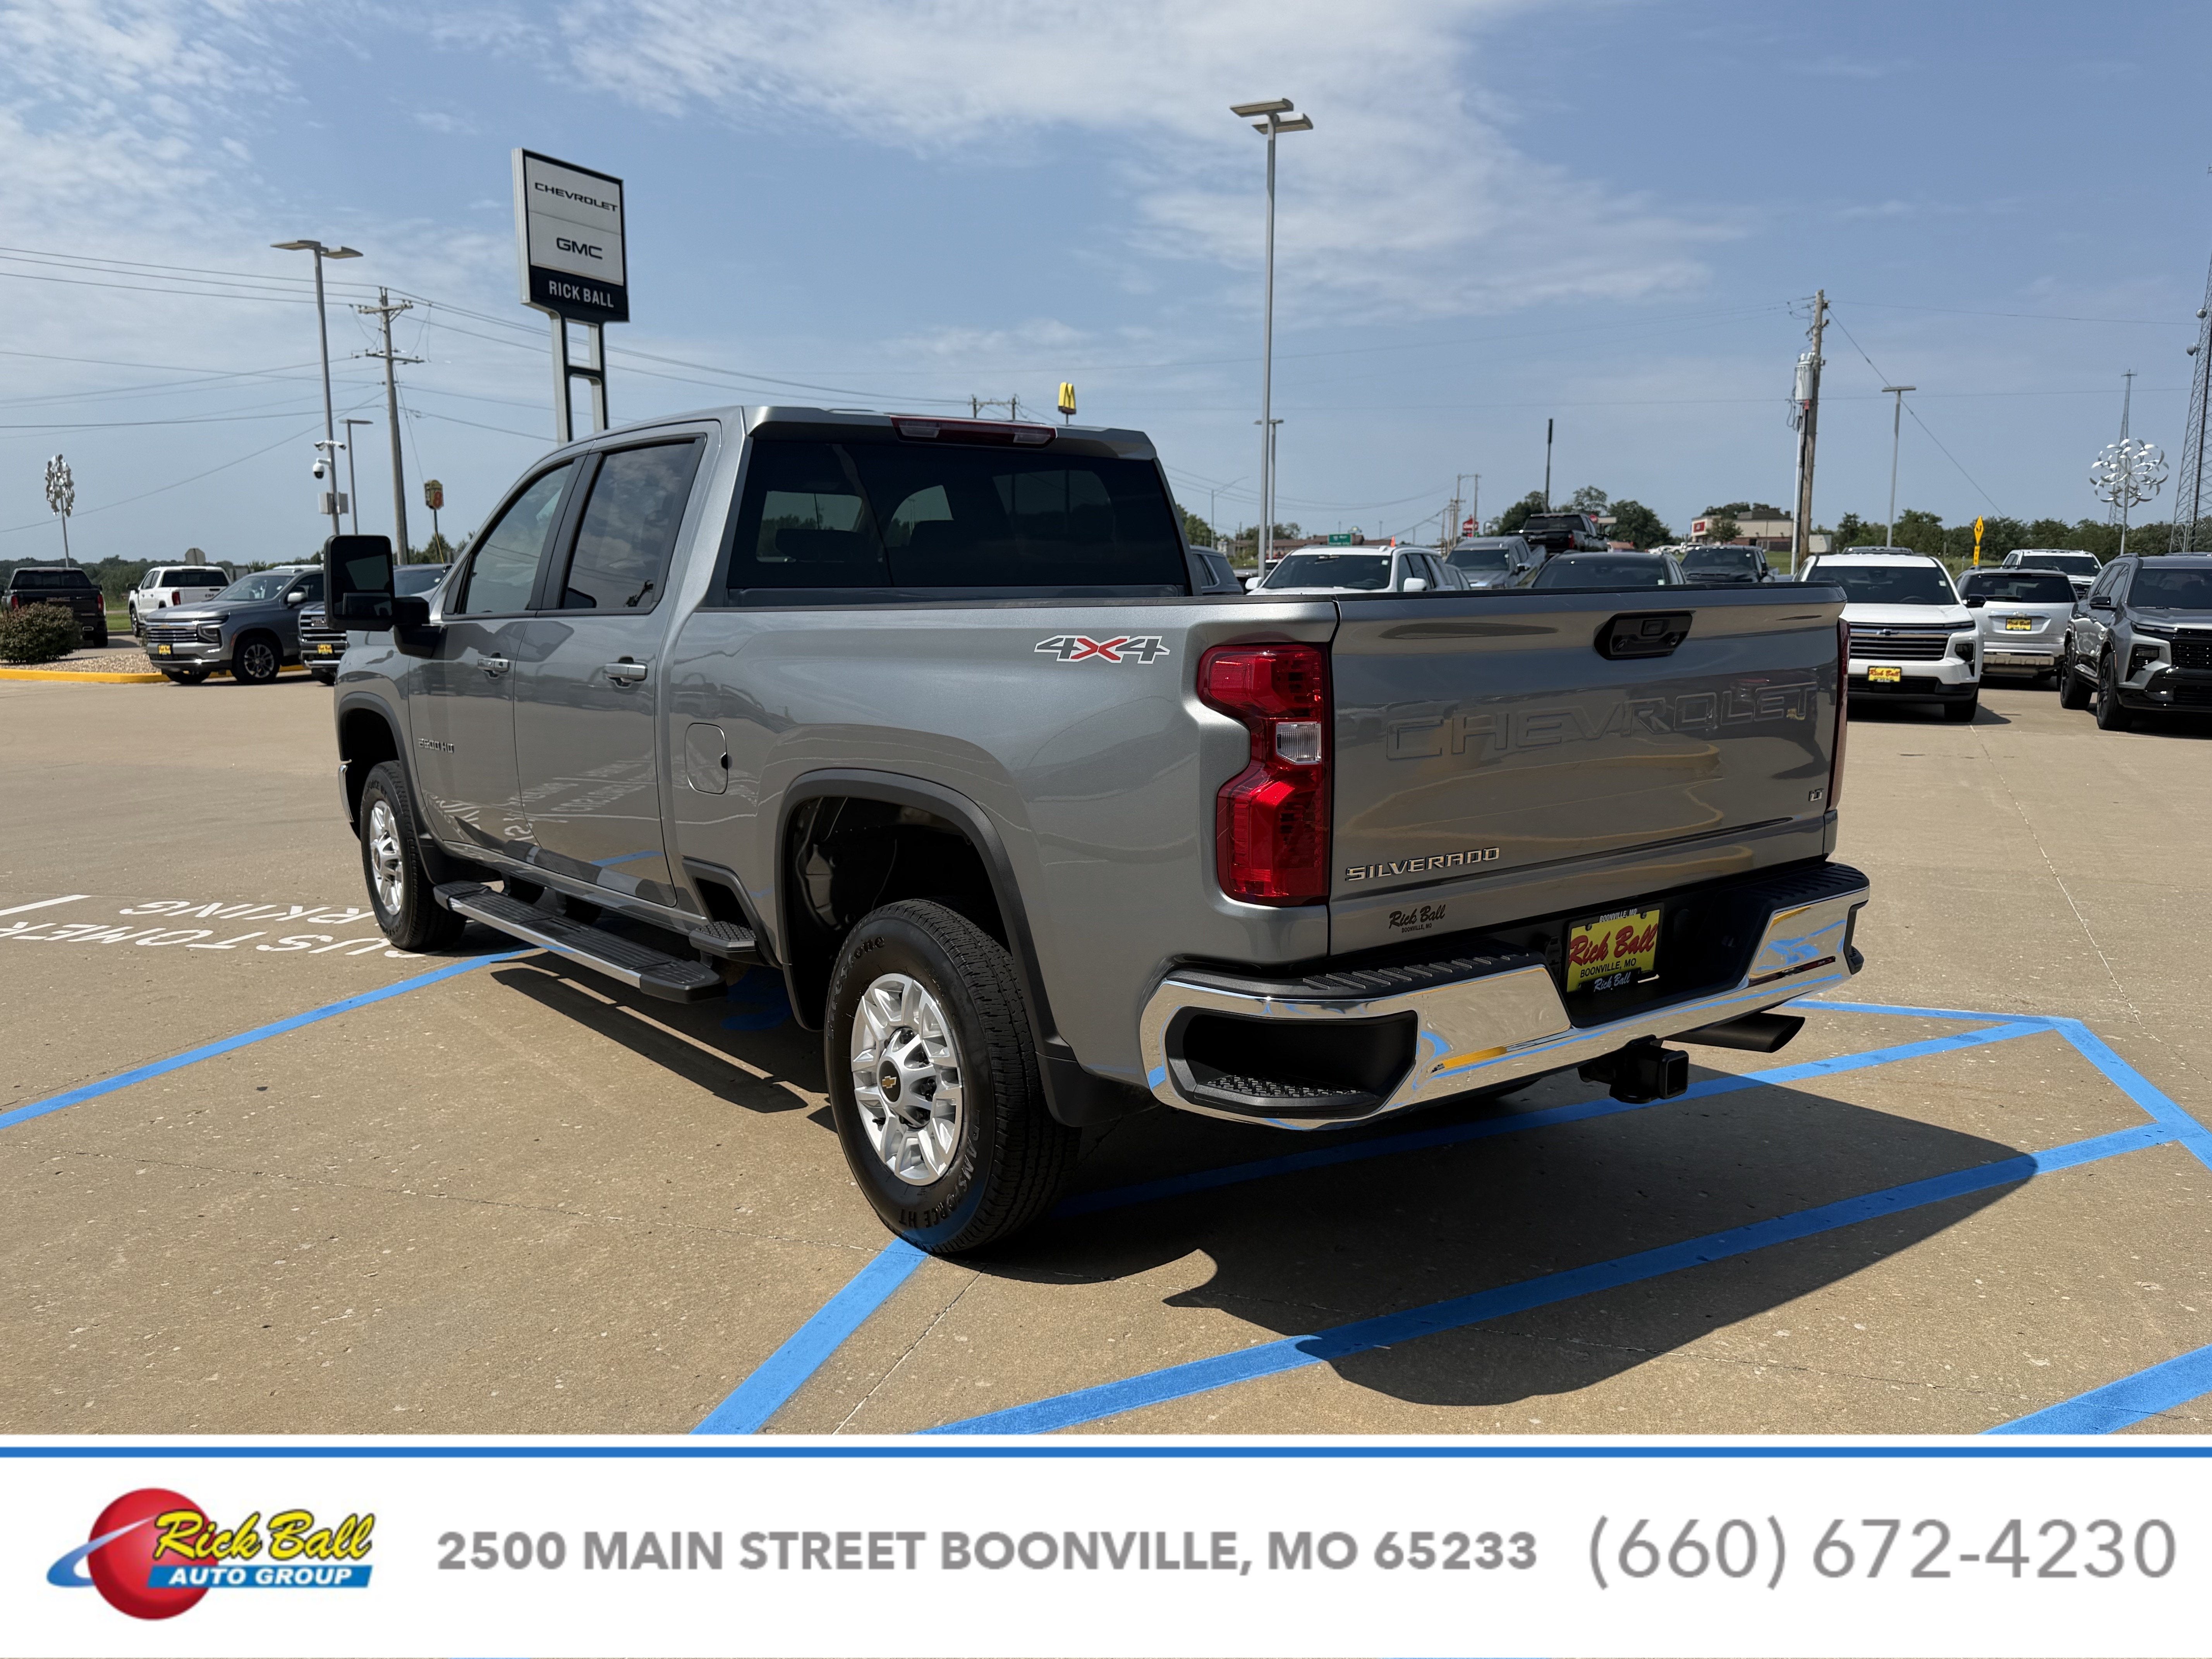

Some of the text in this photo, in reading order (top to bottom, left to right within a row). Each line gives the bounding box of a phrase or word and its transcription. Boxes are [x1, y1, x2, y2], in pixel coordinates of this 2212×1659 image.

[535, 182, 618, 211] CHEVROLET
[556, 237, 603, 260] GMC
[548, 280, 614, 307] RICK BALL
[1034, 635, 1170, 664] 4X4
[1386, 681, 1818, 761] CHEVROLET
[418, 737, 454, 753] 2500 HD
[1808, 788, 1824, 802] LT
[1345, 847, 1499, 881] SILVERADO
[119, 900, 380, 925] RKING
[1389, 904, 1446, 929] Rick Ball
[1629, 908, 1637, 916] MO
[0, 921, 426, 958] USTOMER
[1401, 924, 1424, 933] BOONVILLE,
[1568, 923, 1658, 967] Rick Ball
[1580, 958, 1637, 978] BOONVILLE, MO
[1594, 972, 1631, 992] Rick Ball
[899, 1208, 918, 1228] HT
